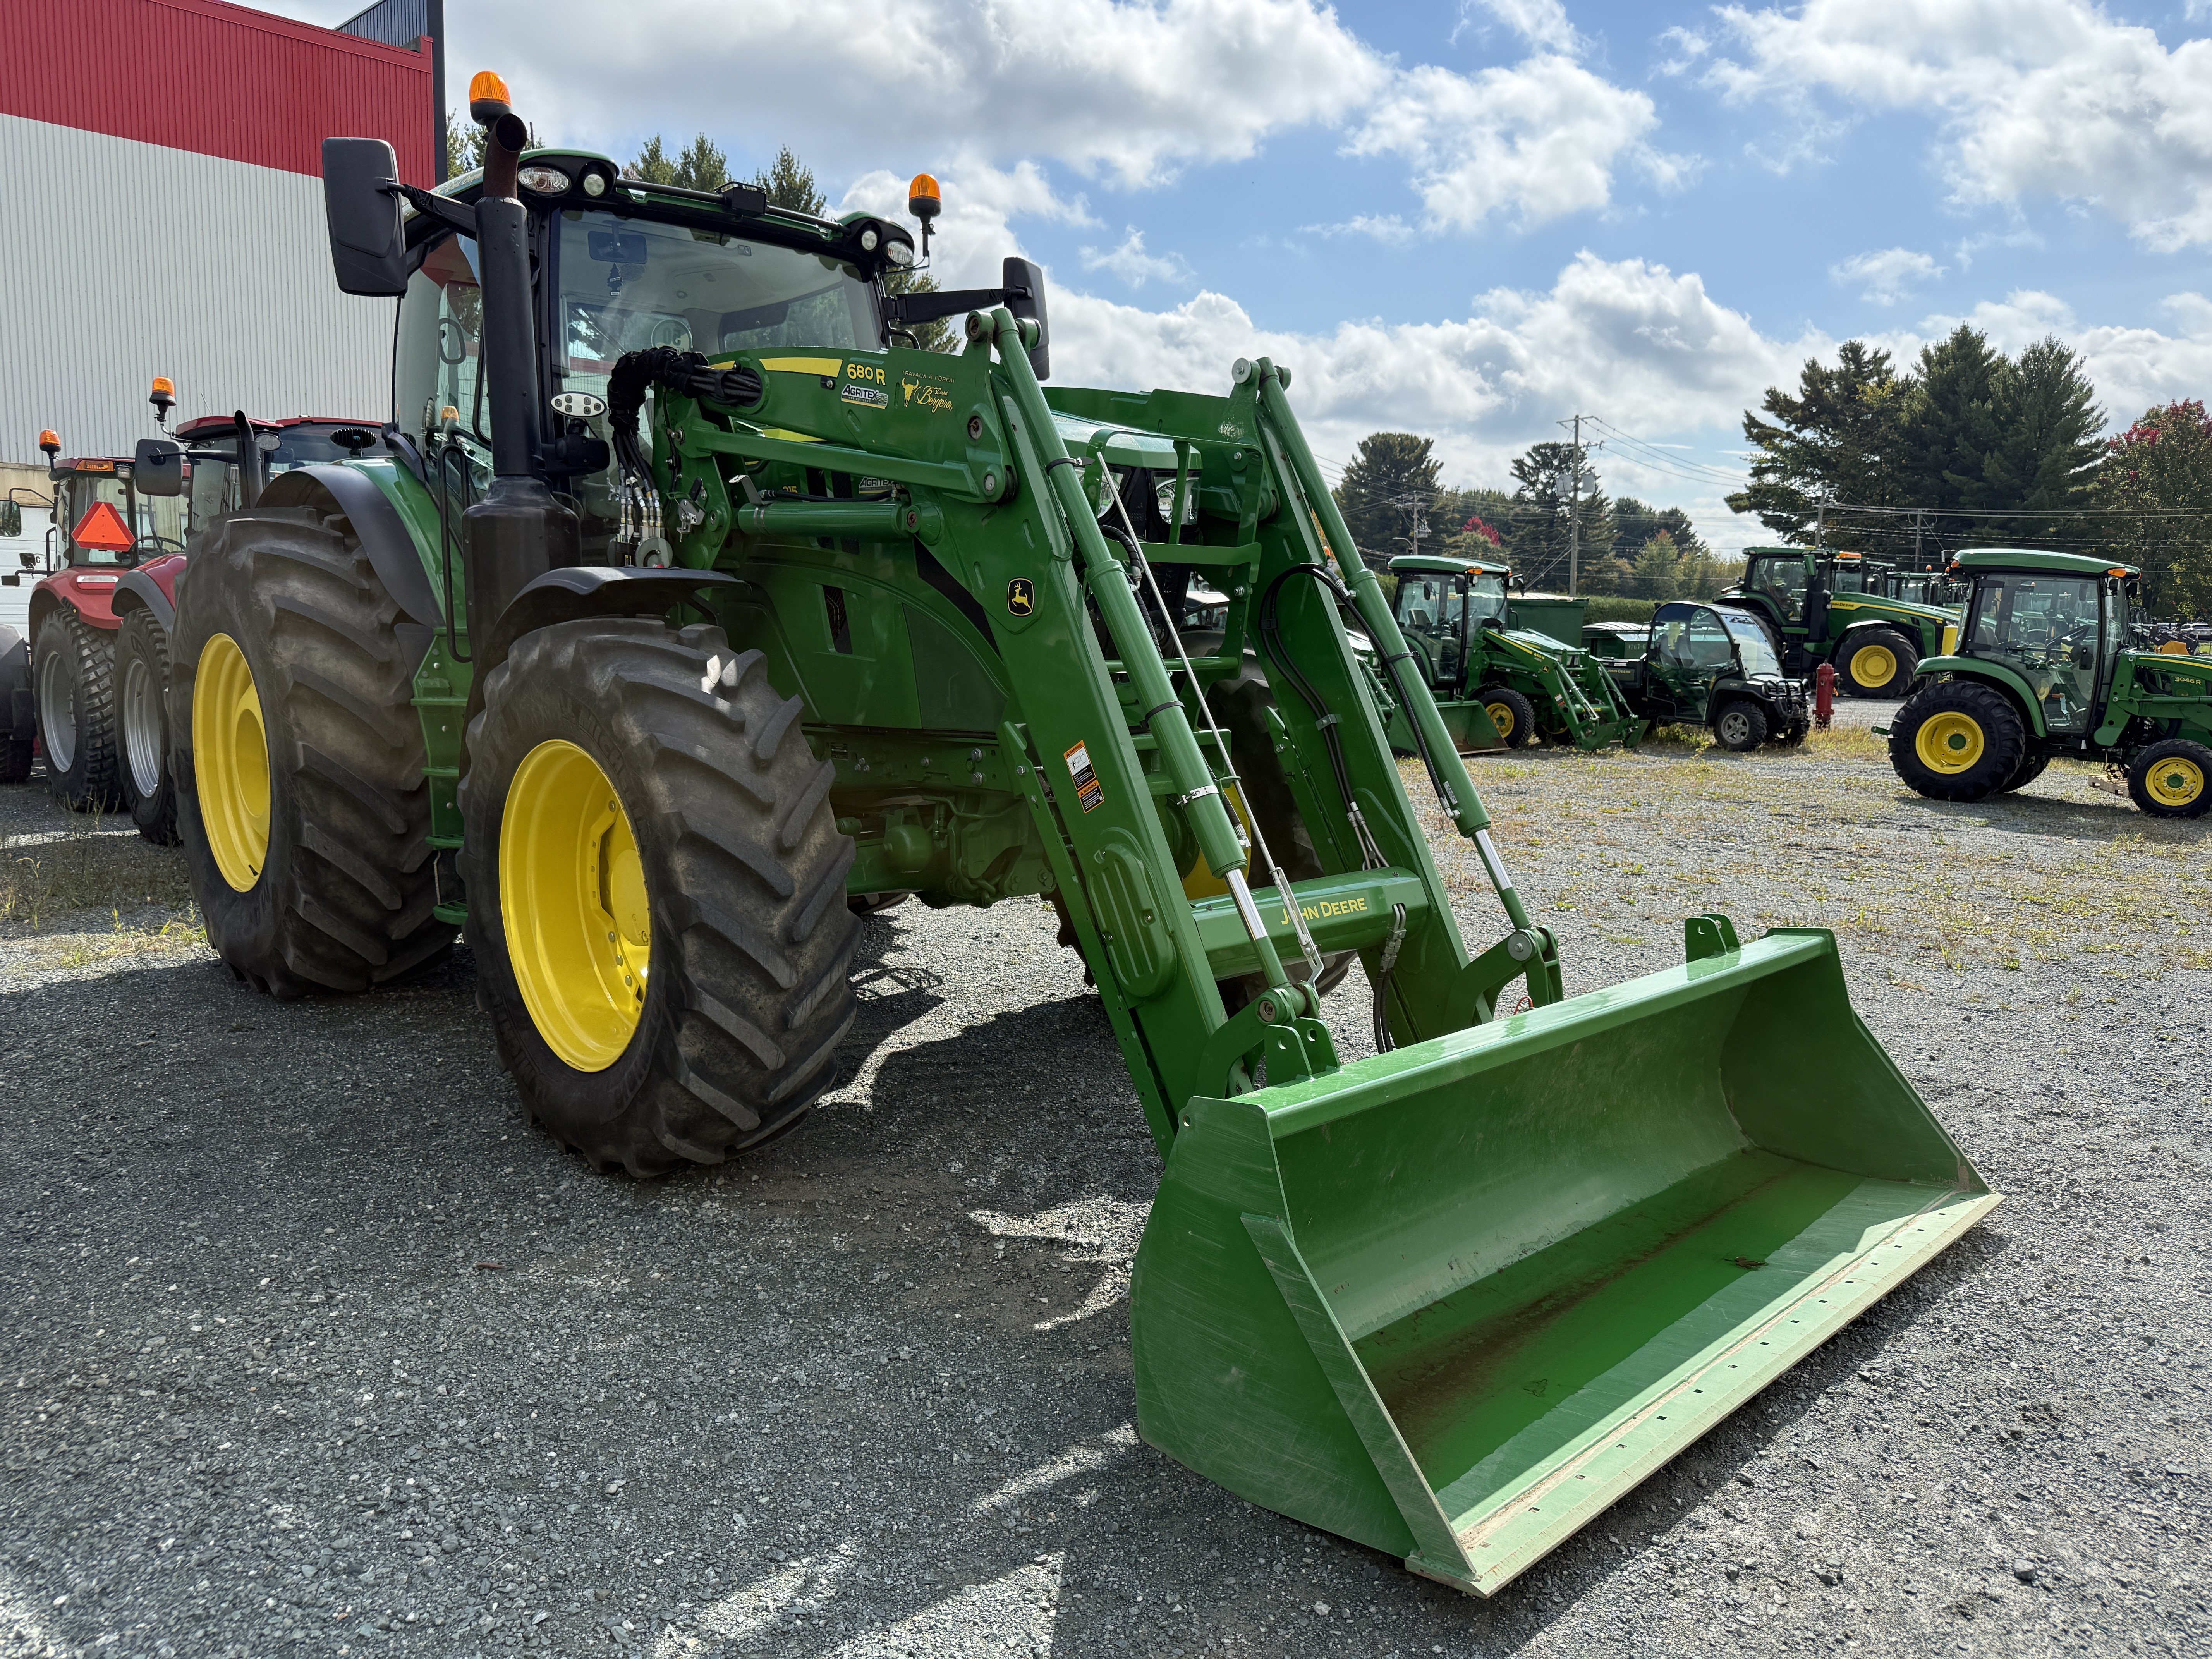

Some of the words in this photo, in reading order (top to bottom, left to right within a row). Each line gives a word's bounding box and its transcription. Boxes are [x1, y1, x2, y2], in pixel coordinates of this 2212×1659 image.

[902, 370, 927, 378] TRAVAUX
[843, 385, 878, 400] AGRITEX
[1281, 906, 1319, 925] JHN
[1319, 898, 1368, 917] DEERE
